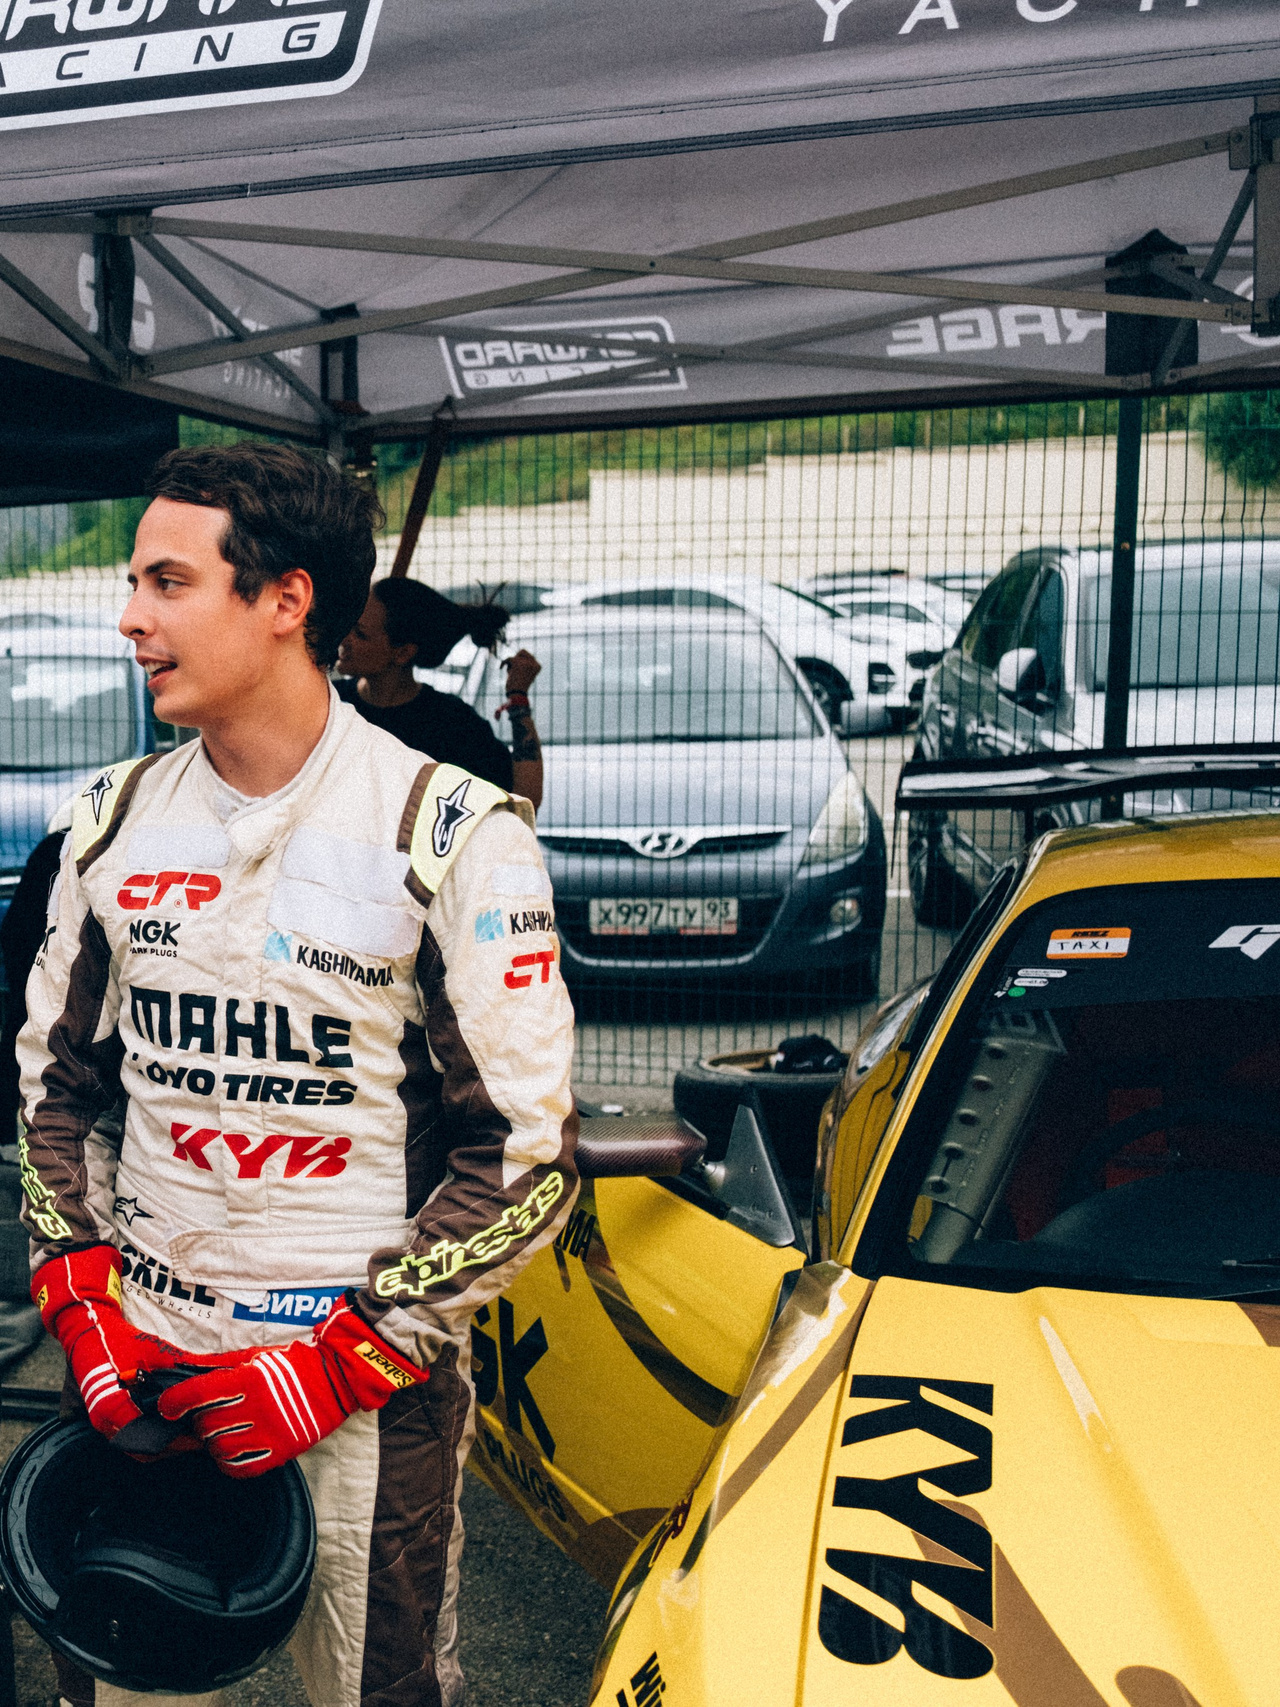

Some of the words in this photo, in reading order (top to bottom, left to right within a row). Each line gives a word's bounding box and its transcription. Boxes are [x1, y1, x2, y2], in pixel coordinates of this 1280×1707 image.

[117, 871, 221, 910] CTP
[129, 919, 180, 947] NGK
[150, 948, 177, 957] PLUGS
[1057, 941, 1109, 950] TAXI
[296, 945, 394, 986] KASHIYAMA
[504, 951, 555, 989] CT
[129, 985, 354, 1068] MAHLE
[132, 1052, 216, 1096] OYO
[223, 1074, 358, 1106] TIRES
[171, 1122, 352, 1179] KYB
[249, 1292, 337, 1318] ВИРА
[818, 1374, 995, 1681] KYB
